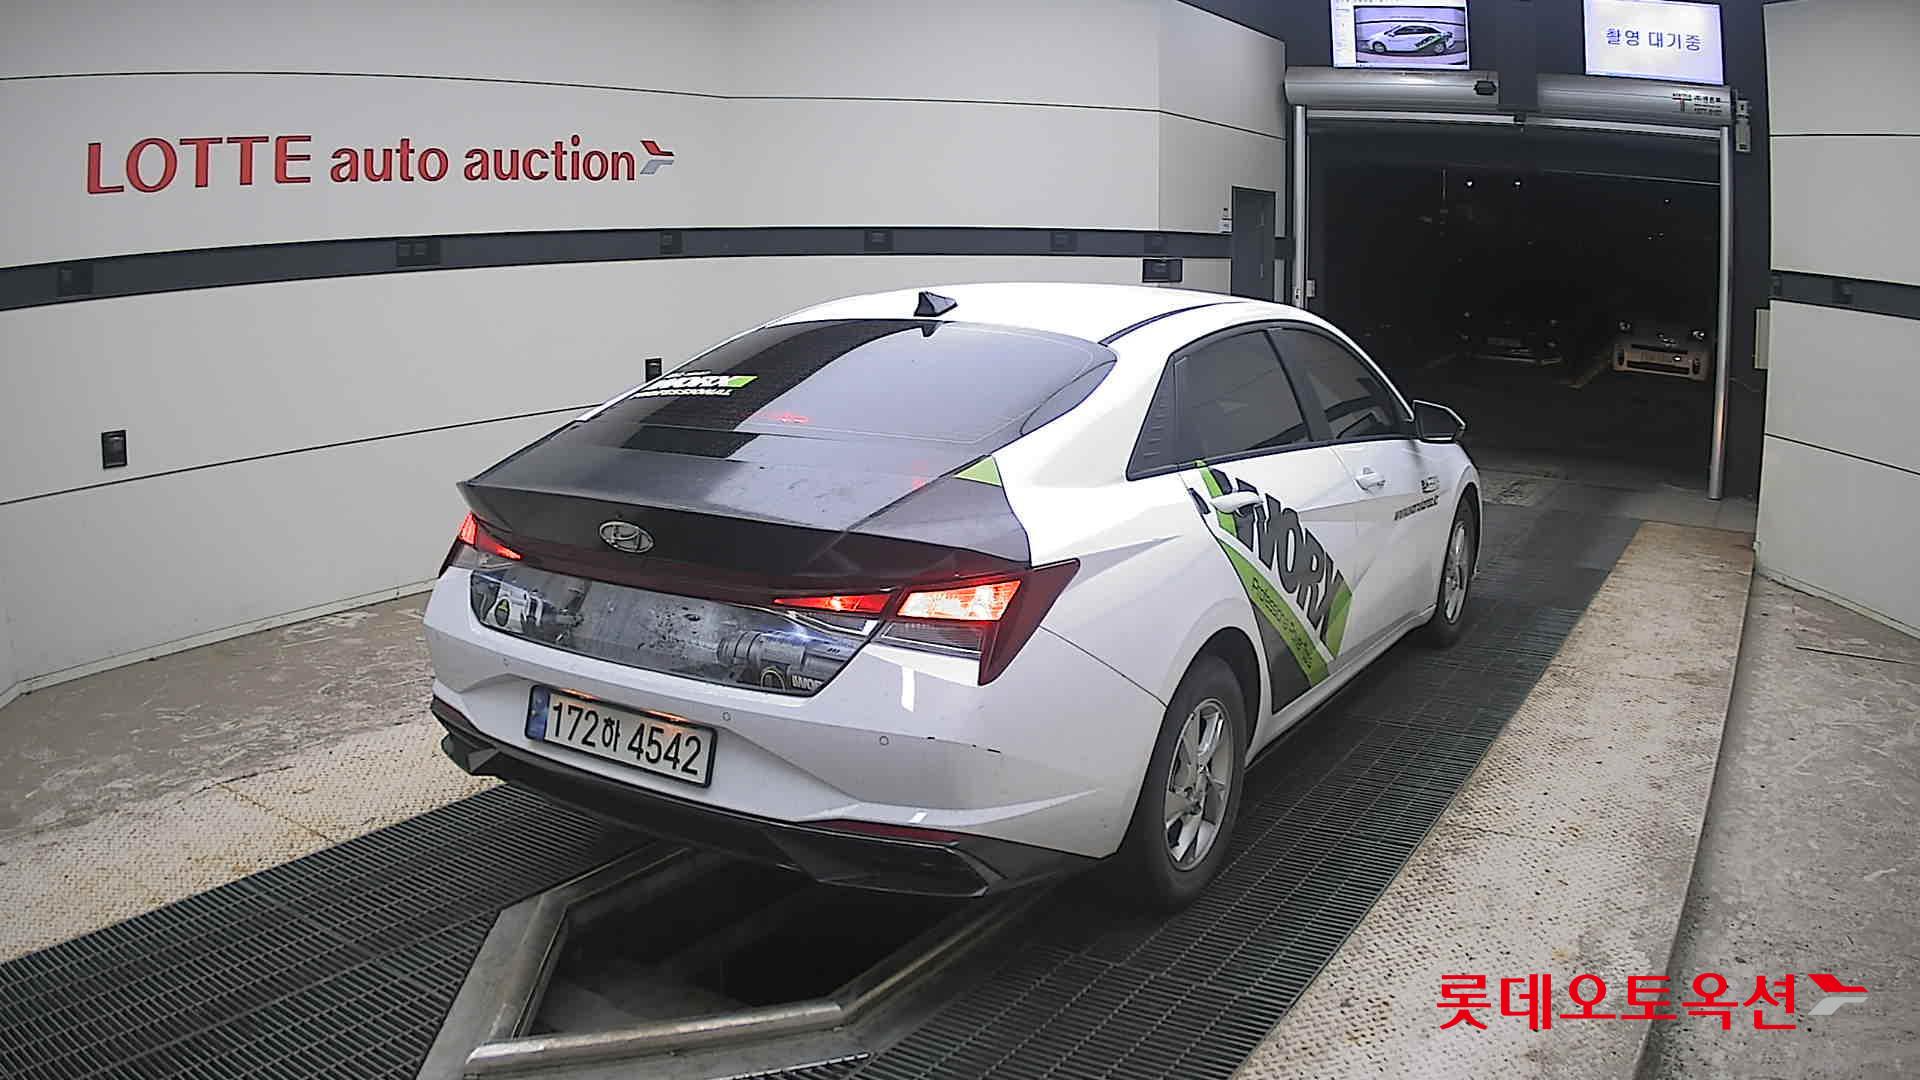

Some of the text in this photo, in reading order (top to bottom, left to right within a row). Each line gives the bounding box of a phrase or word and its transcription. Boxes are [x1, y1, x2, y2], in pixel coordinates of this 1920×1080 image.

[1648, 31, 1701, 51] 대기중
[87, 134, 636, 195] LOTTE auto auction
[552, 701, 701, 776] 172하 4542
